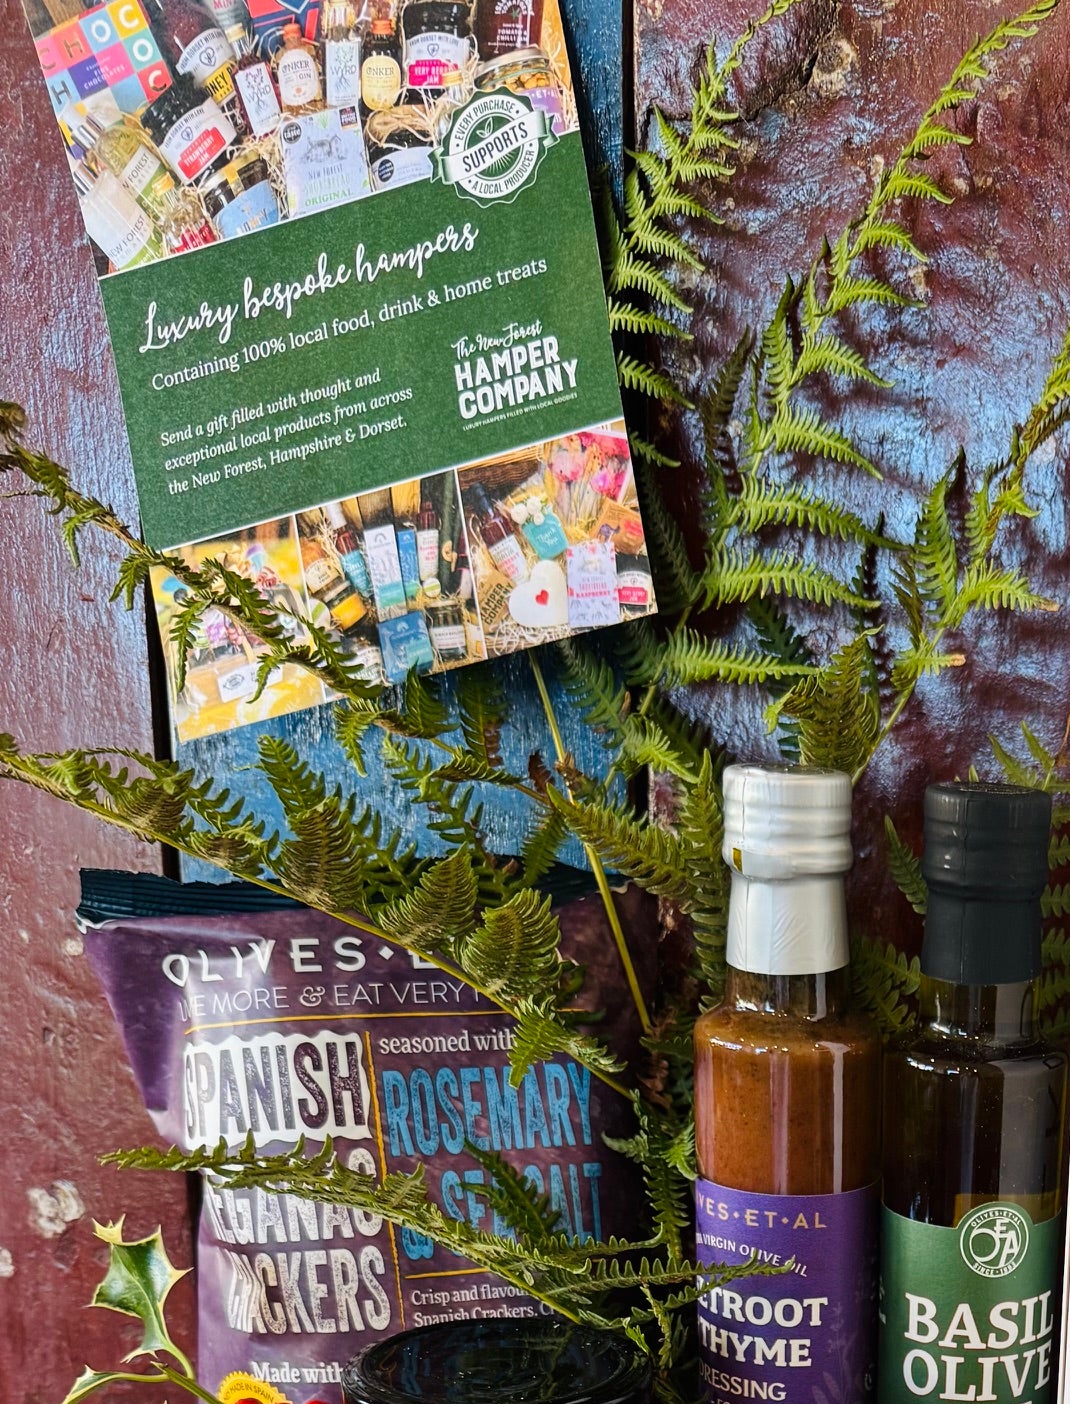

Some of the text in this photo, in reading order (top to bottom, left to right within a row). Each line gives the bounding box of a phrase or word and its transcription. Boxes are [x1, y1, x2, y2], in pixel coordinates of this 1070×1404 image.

[454, 99, 516, 141] EVERY PURCHASE
[462, 121, 528, 173] SUPPORTS
[479, 182, 502, 194] LOCAL
[139, 222, 478, 353] Luxury bespoke hampers
[151, 258, 548, 391] Containing 100% local food, drink & home treats
[476, 334, 503, 351] New
[454, 335, 560, 391] HAMPER
[459, 358, 578, 420] COMPANY
[161, 368, 381, 447] Send gift filled with thought and
[165, 387, 412, 471] exceptional local products from across
[168, 415, 407, 495] the New Forest, Hampshire & Dorset.
[213, 980, 466, 1015] MORE & EAT VERY
[379, 1029, 518, 1055] seasoned with
[184, 1042, 363, 1137] SPANISH
[382, 1062, 593, 1157] ROSEMARY
[703, 1234, 736, 1252] VIRGIN
[412, 1286, 479, 1306] Crisp and
[904, 1291, 1053, 1350] BASIL
[700, 1315, 812, 1367] THYME
[251, 1362, 301, 1383] Made
[903, 1340, 1052, 1402] OLIVE
